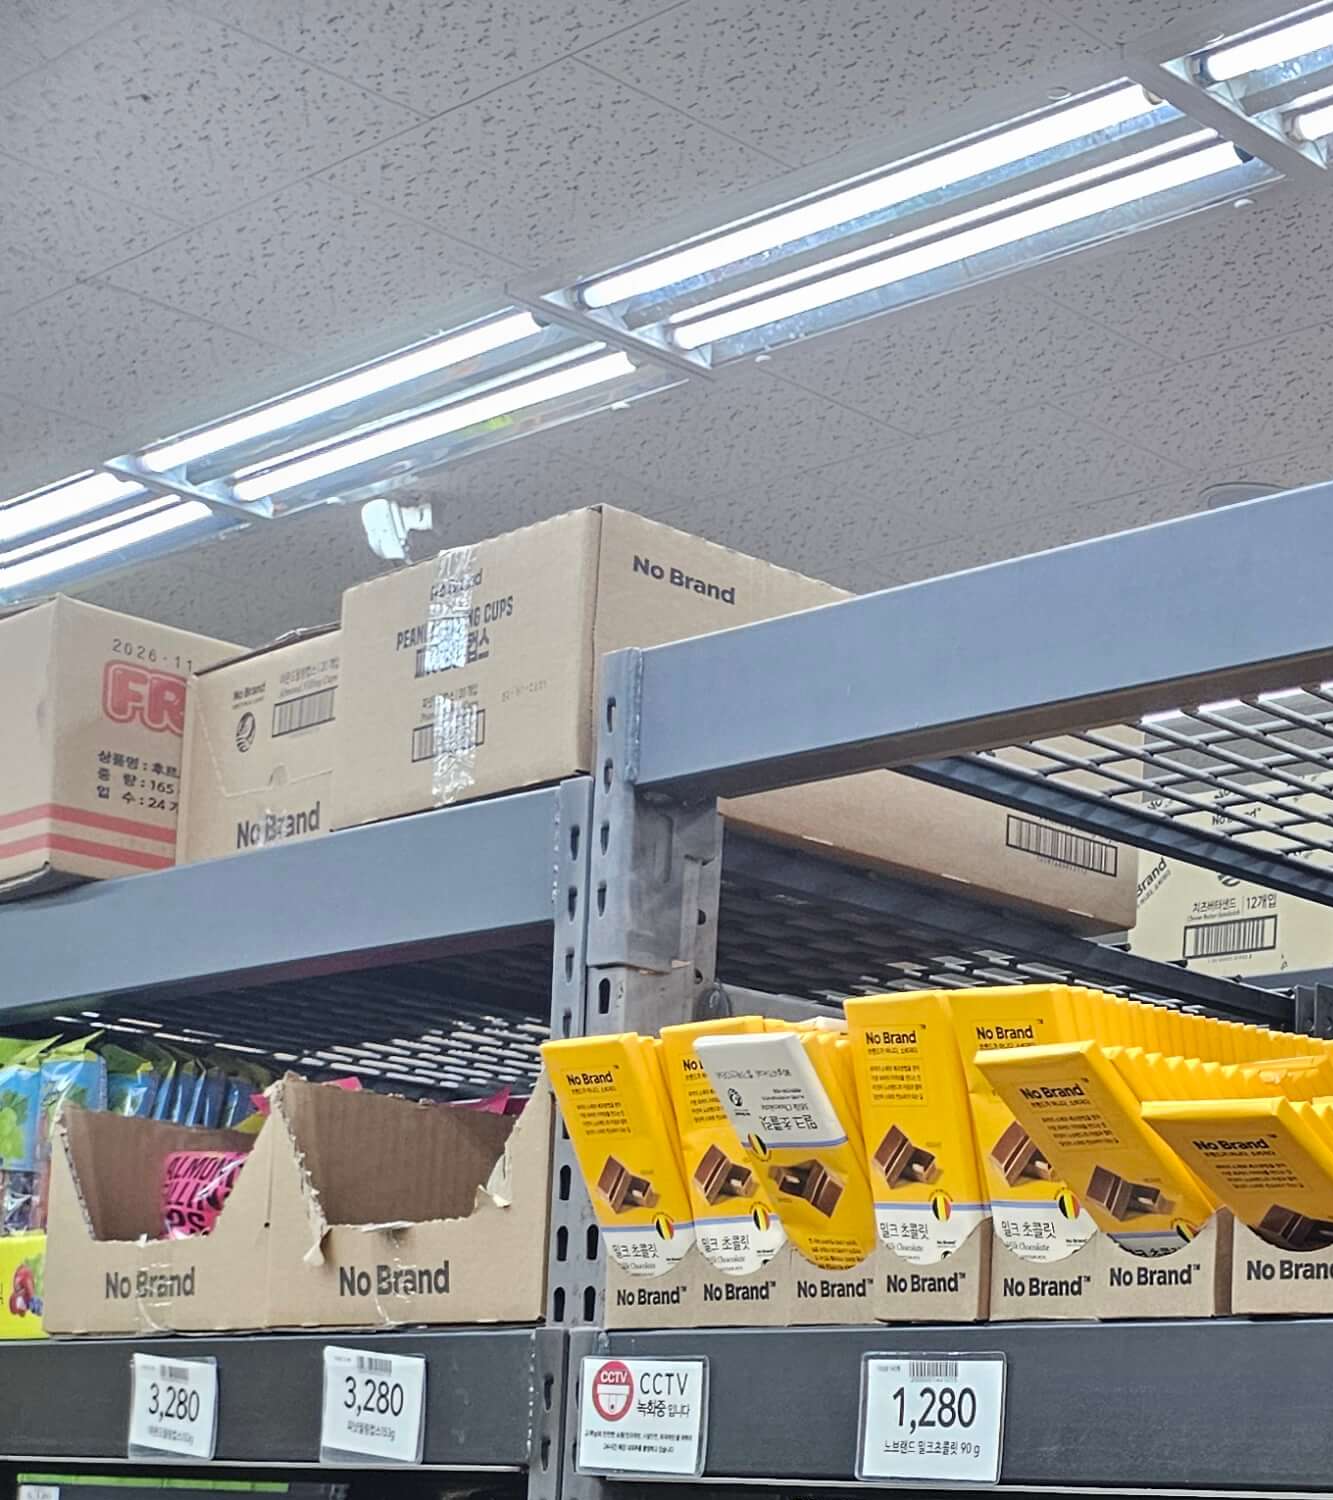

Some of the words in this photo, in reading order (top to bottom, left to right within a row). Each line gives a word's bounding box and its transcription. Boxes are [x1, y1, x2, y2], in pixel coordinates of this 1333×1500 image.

[632, 555, 664, 580] No
[669, 567, 736, 605] Brand
[484, 595, 514, 622] CUPS
[237, 822, 261, 849] No
[265, 801, 320, 842] Brand
[1000, 1222, 1020, 1238] 밀크
[1022, 1220, 1057, 1240] 초콜릿
[105, 1271, 131, 1299] No
[136, 1266, 195, 1297] Brand
[339, 1266, 371, 1298] No
[376, 1260, 451, 1297] Brand
[1003, 1278, 1025, 1298] No
[1027, 1275, 1083, 1297] Brand
[617, 1289, 635, 1307] No
[637, 1285, 681, 1305] Brand
[600, 1370, 629, 1384] CCTV
[639, 1372, 689, 1397] CCTV
[148, 1383, 201, 1424] 3,280
[343, 1376, 405, 1417] 3,280
[637, 1399, 666, 1417] 녹화중
[892, 1386, 978, 1434] 1,280
[884, 1439, 917, 1456] 노브랜드
[918, 1440, 959, 1458] 밀크초콜릿
